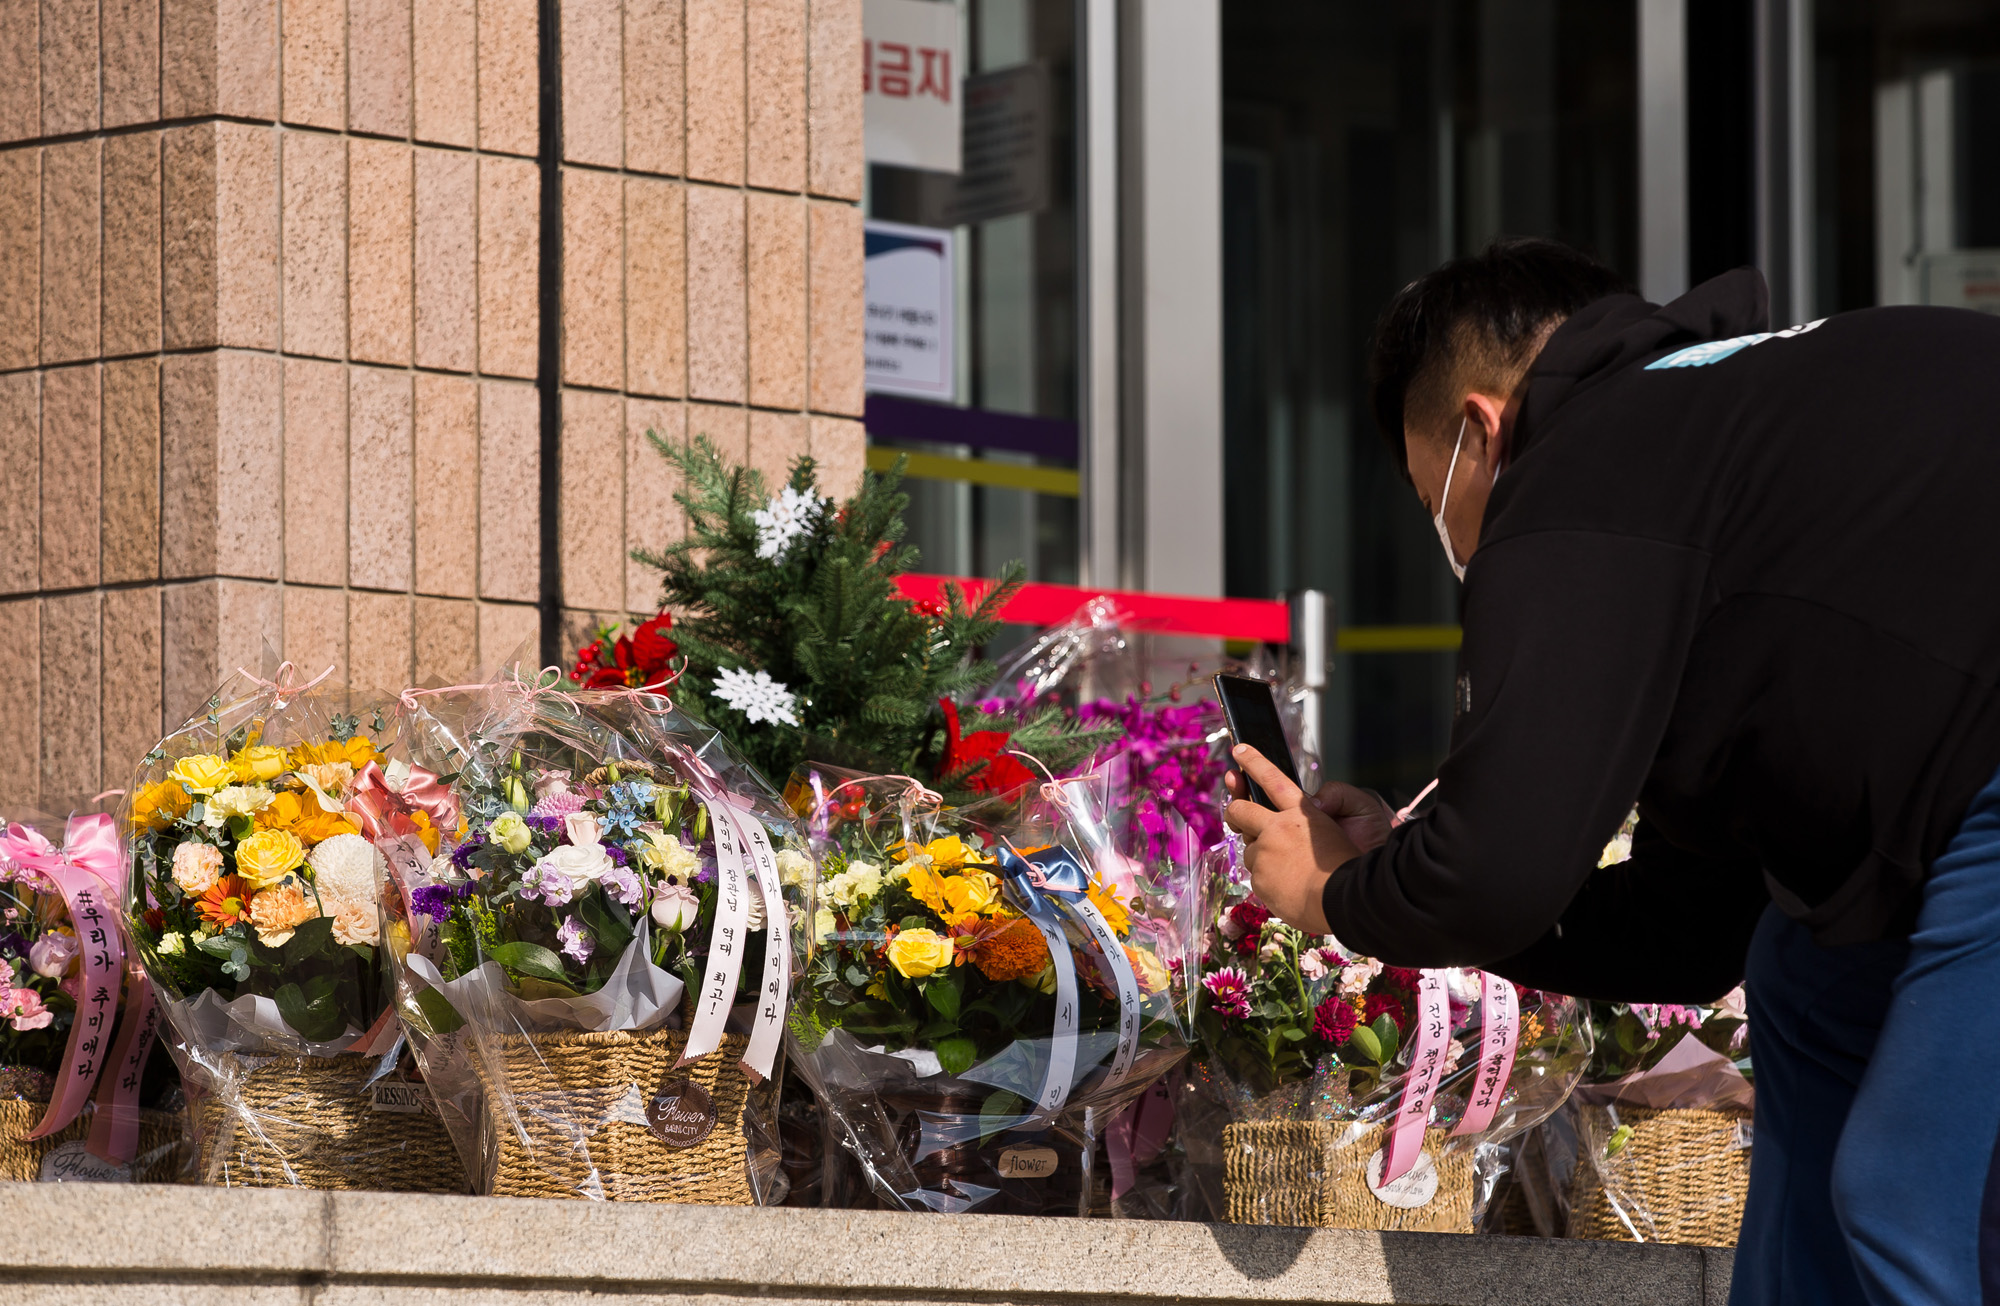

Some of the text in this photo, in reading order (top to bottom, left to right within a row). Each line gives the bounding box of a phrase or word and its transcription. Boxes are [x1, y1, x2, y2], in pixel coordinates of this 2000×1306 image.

[719, 927, 734, 957] 역대
[752, 831, 782, 1027] 우리가 추미애다
[76, 889, 115, 1081] #우리가 추미애다
[708, 971, 727, 1016] 최고!
[1083, 906, 1133, 1082] 우리가 추미애다
[1428, 1003, 1444, 1039] 건강
[1491, 1011, 1512, 1048] 가슴이
[123, 991, 159, 1094] 원합니다
[375, 1086, 420, 1107] BLESSING
[1407, 1048, 1440, 1115] 챙기세요
[657, 1095, 706, 1123] Flower
[53, 1151, 119, 1180] Flower
[1010, 1154, 1048, 1173] flower
